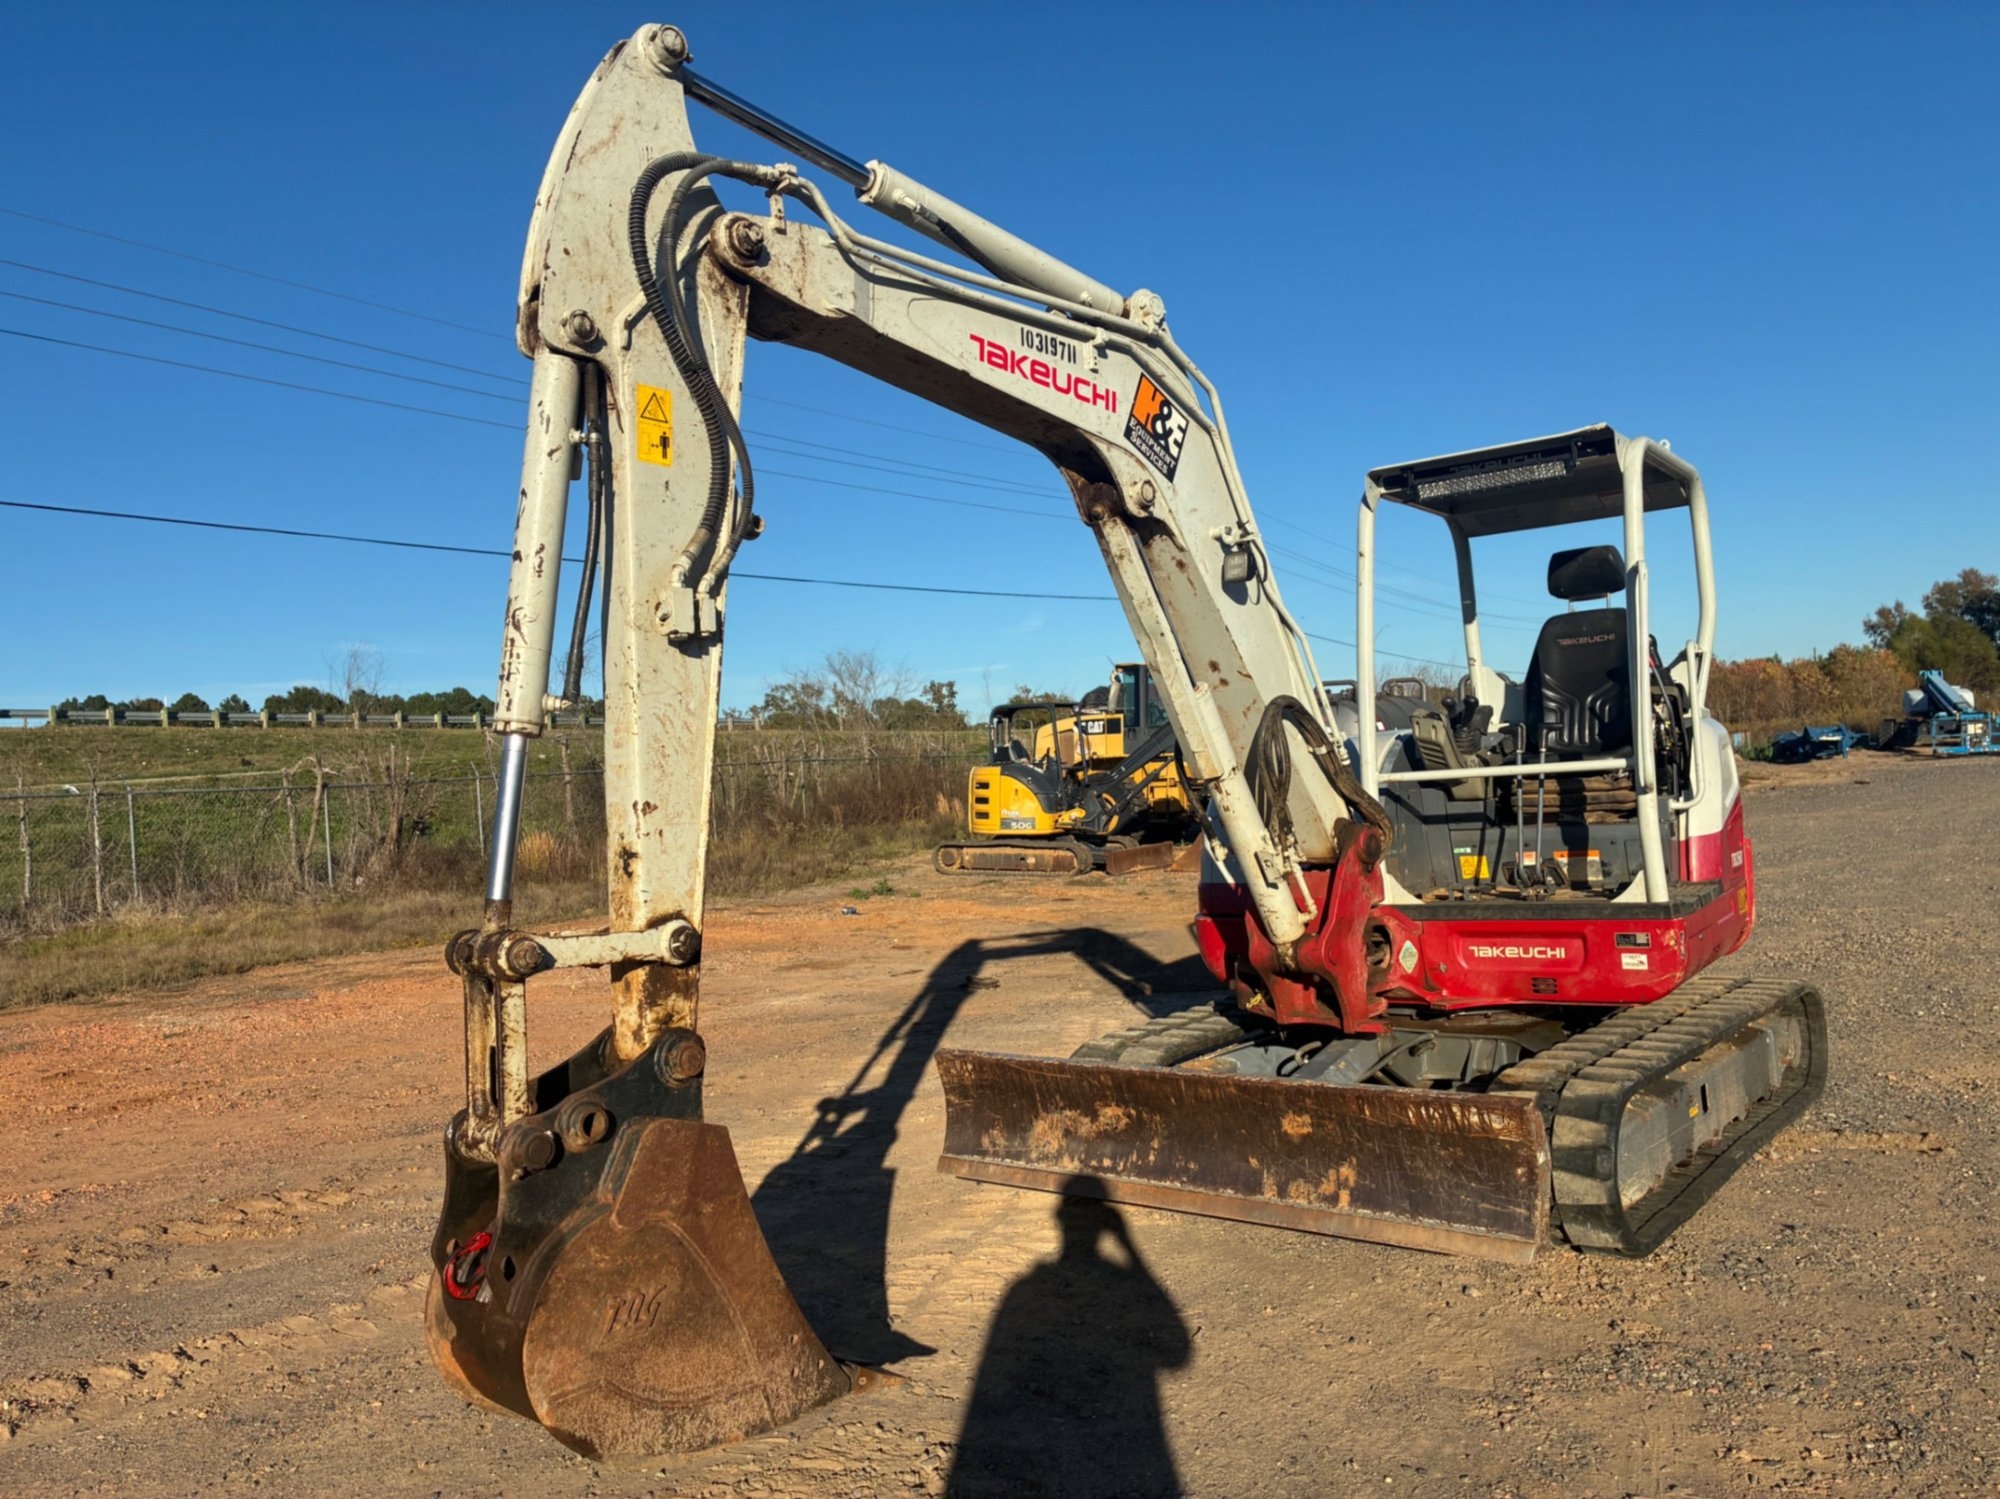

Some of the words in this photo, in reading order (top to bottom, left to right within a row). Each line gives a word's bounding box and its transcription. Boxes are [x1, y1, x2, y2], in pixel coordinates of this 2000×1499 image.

[1020, 327, 1077, 364] 10319711
[1132, 376, 1188, 460] H&E
[1129, 416, 1176, 468] EQUIPMENT
[1130, 431, 1168, 474] SERVICES
[1087, 720, 1105, 734] CAT
